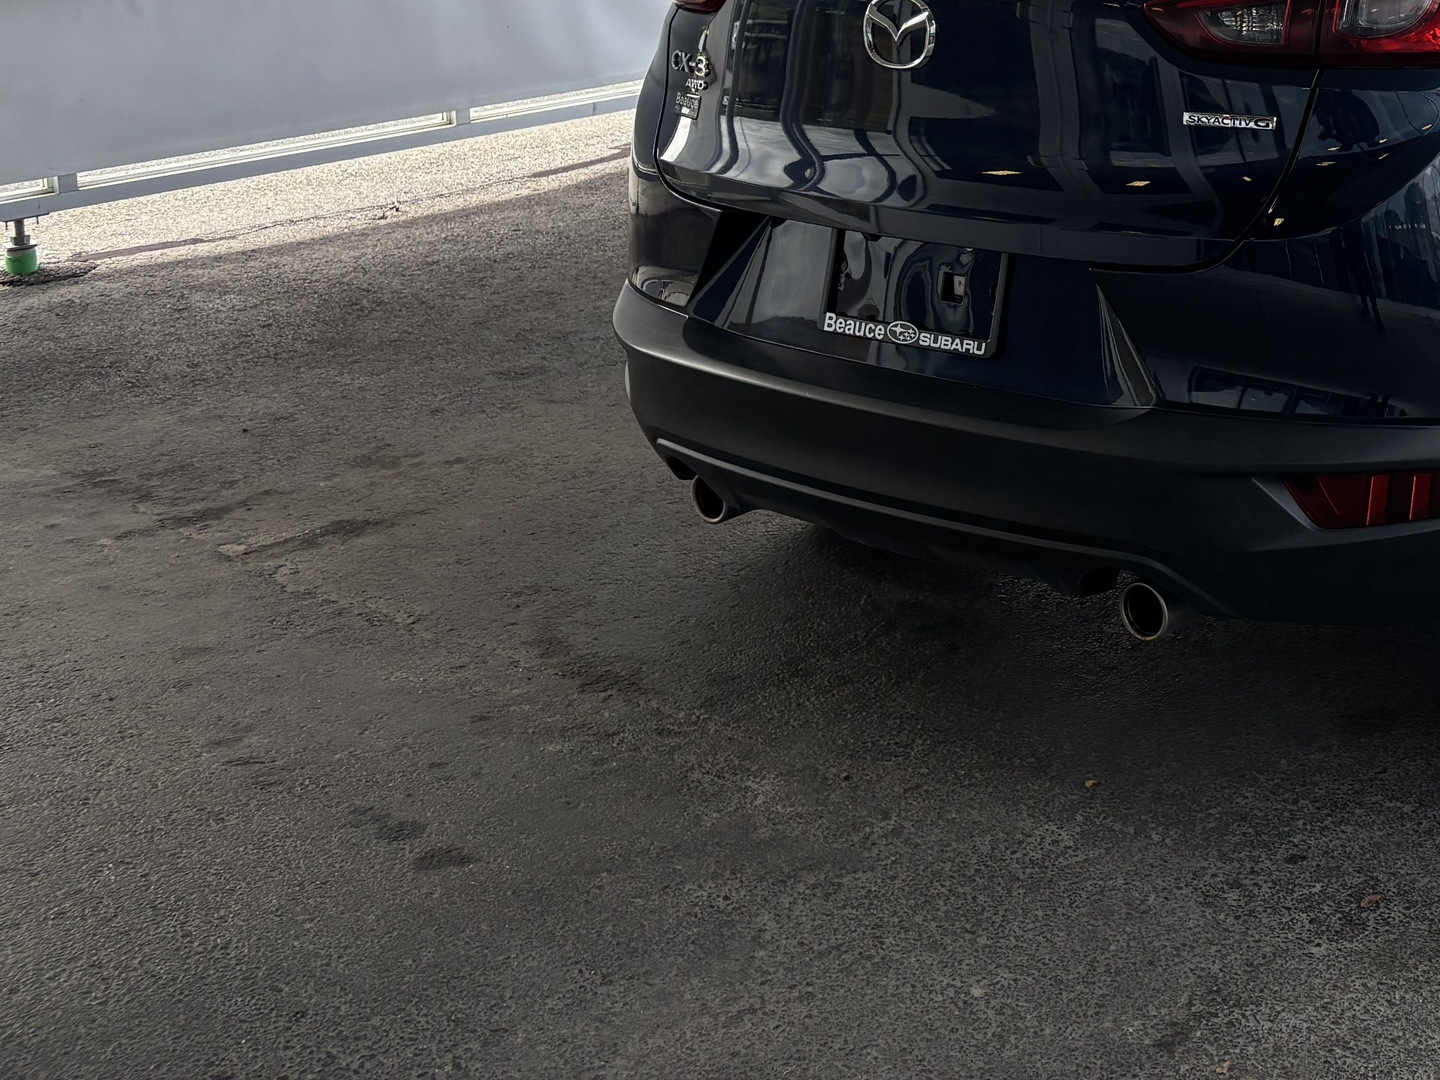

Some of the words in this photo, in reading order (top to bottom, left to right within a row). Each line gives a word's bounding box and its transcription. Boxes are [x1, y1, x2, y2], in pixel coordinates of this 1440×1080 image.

[671, 50, 707, 77] CX-3
[823, 311, 885, 340] Beauce
[918, 332, 986, 356] SUBARU
